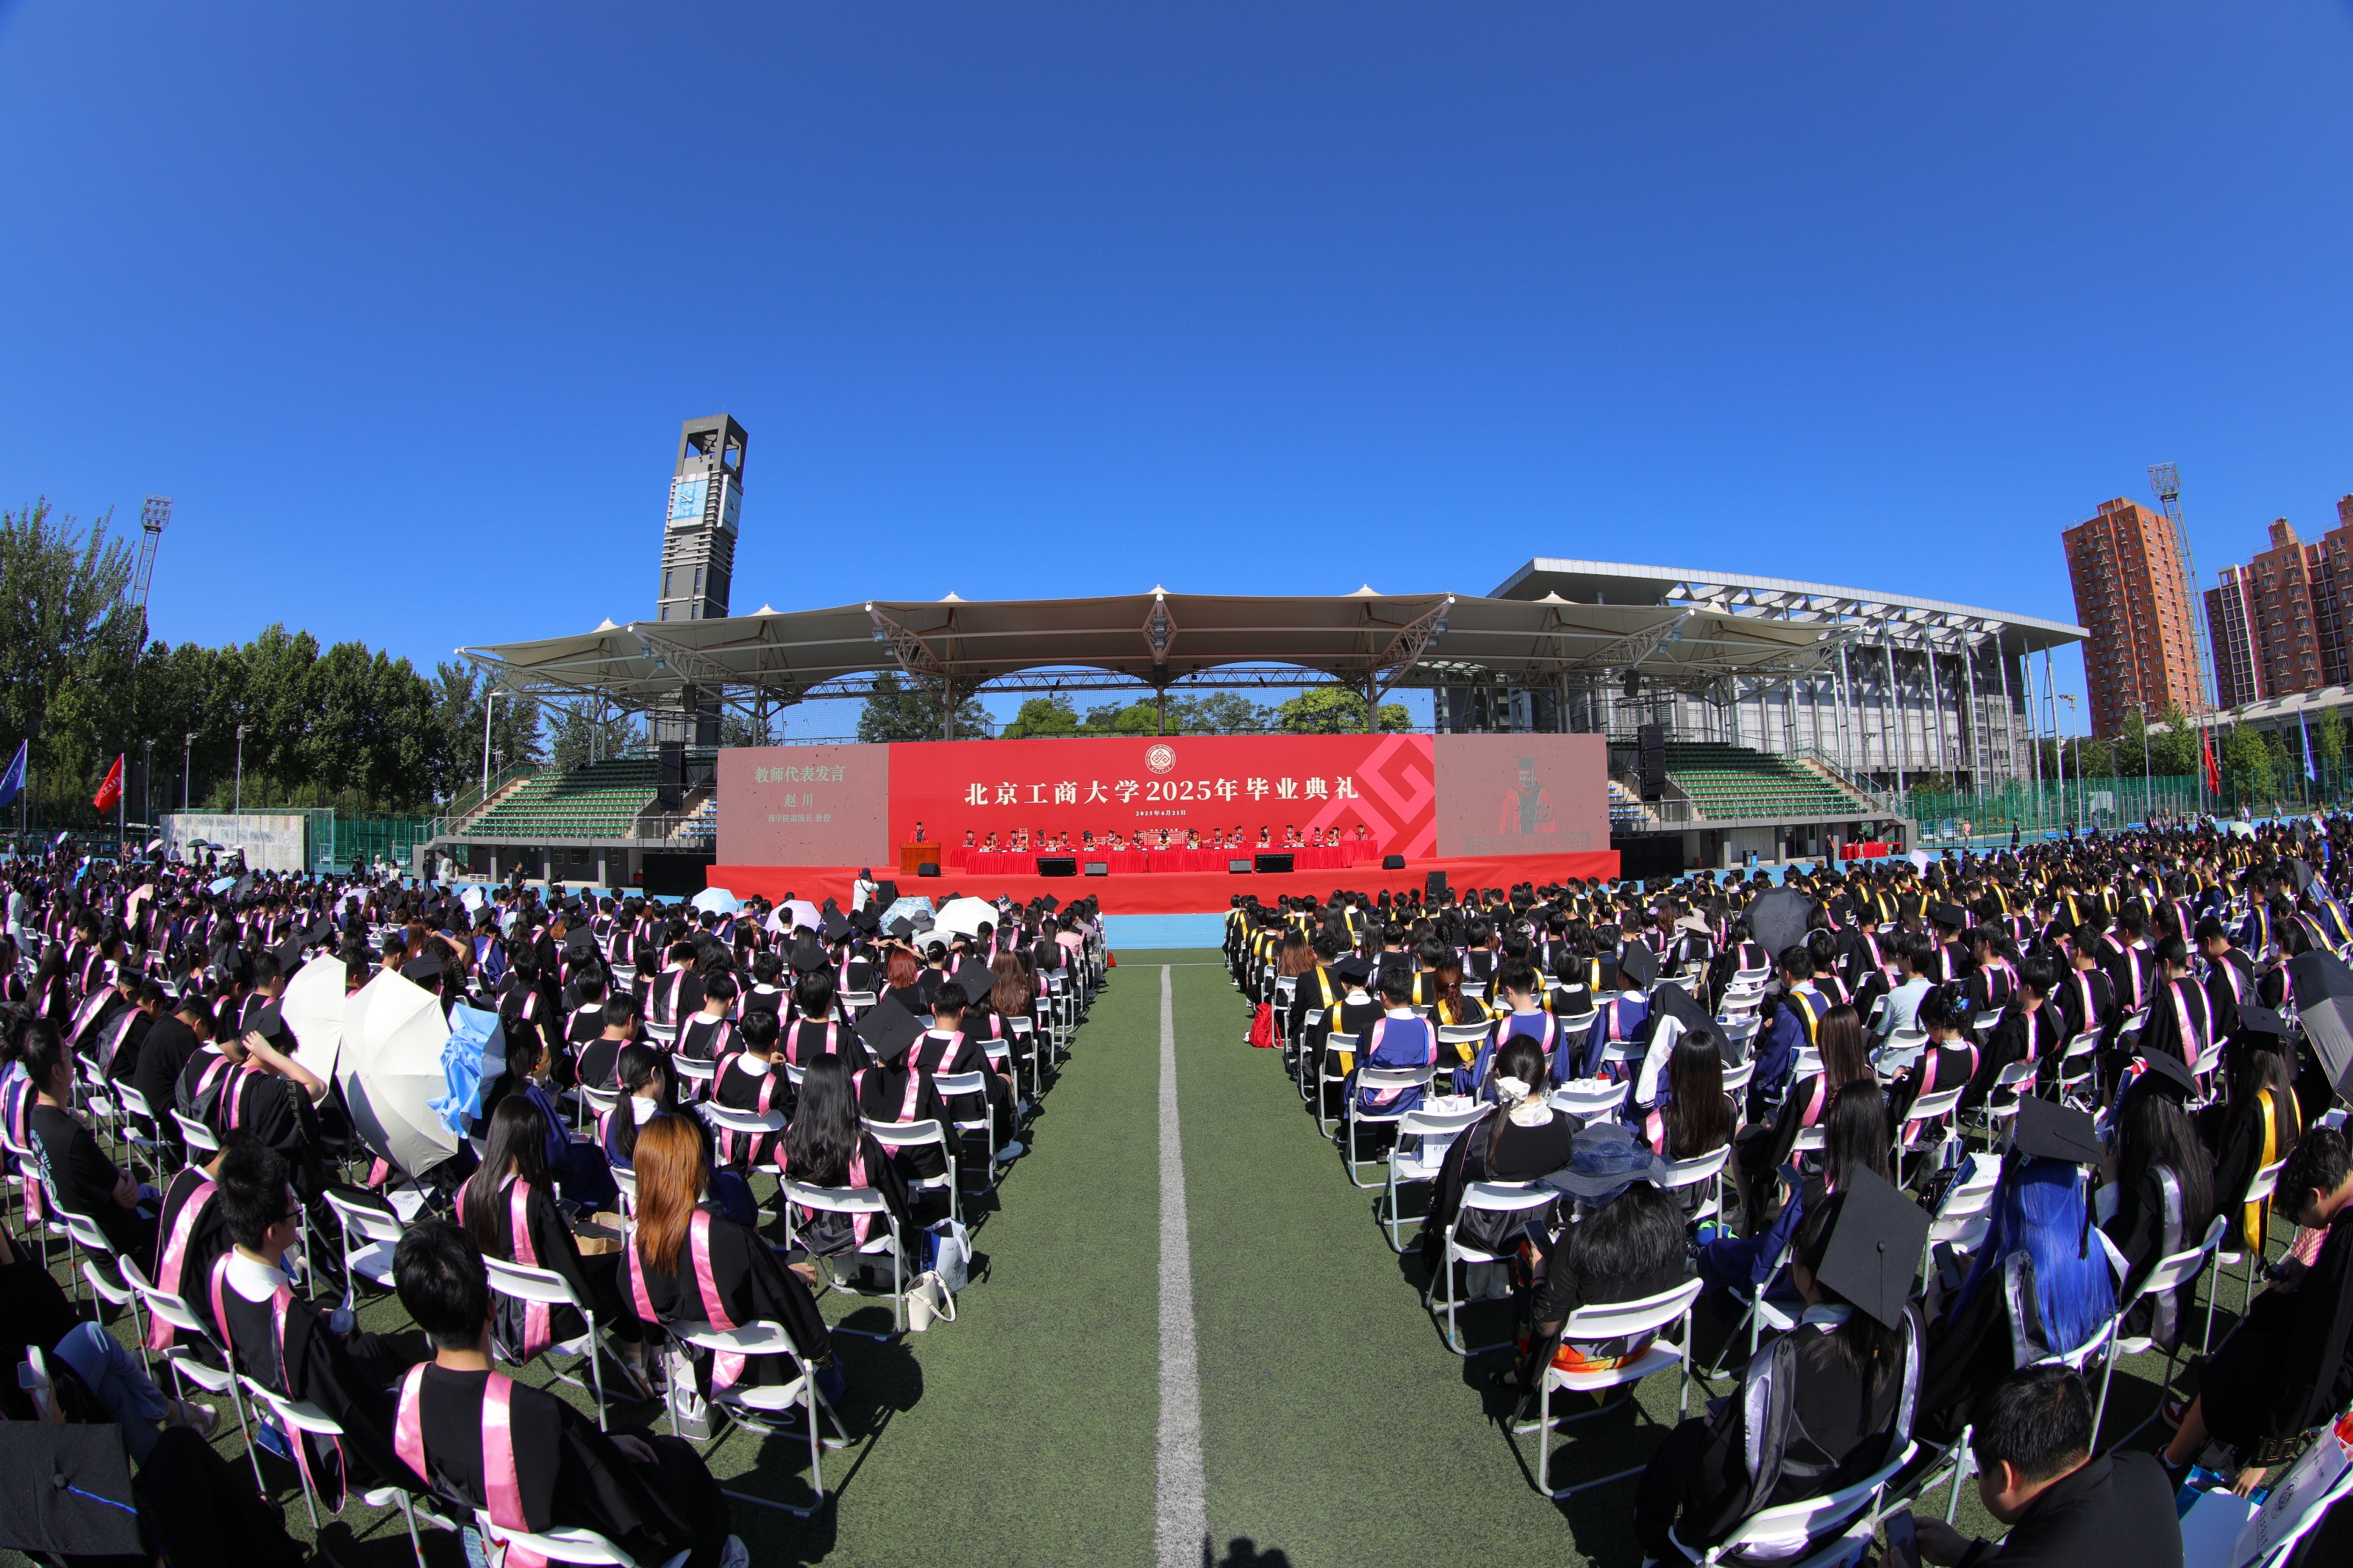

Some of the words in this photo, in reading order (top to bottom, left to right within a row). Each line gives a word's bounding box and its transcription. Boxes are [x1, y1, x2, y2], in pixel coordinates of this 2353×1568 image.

[755, 765, 846, 784] 教师代表发言
[964, 776, 1360, 806] 北京工商大学2025年毕业典礼
[815, 814, 831, 823] 教授
